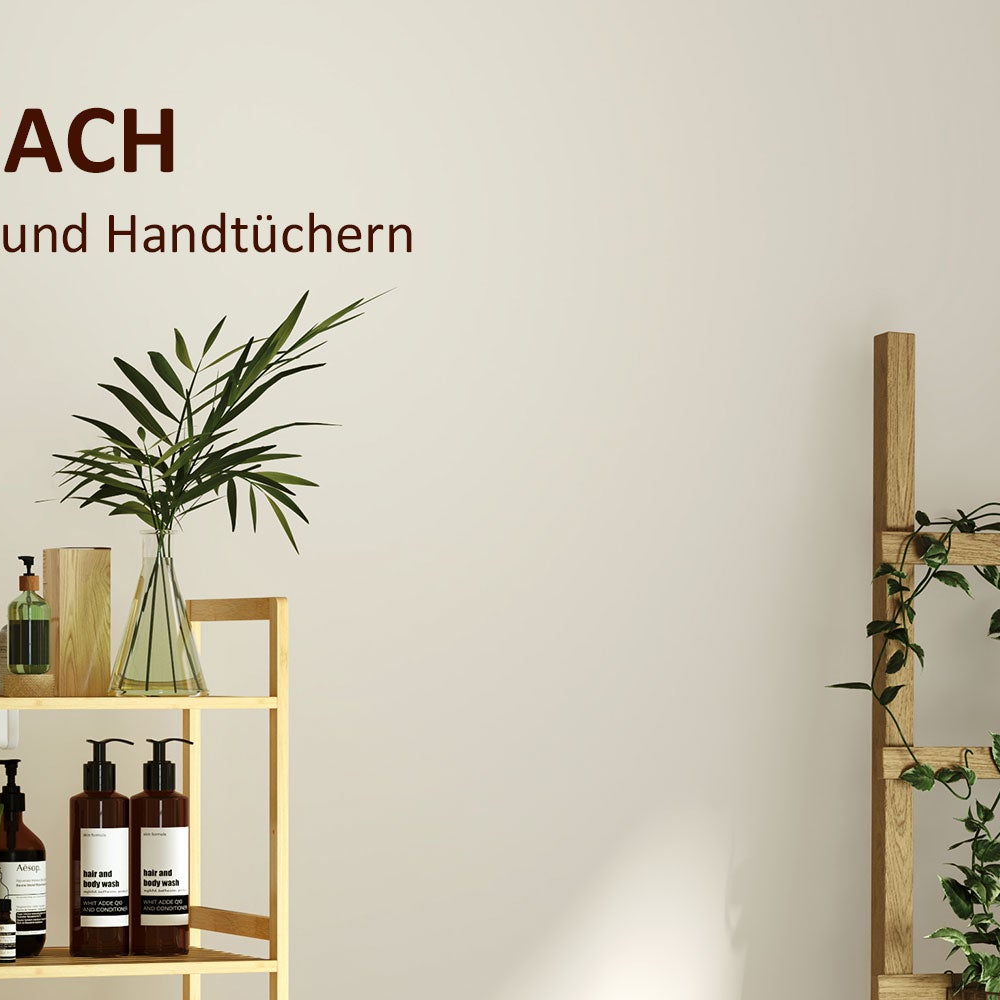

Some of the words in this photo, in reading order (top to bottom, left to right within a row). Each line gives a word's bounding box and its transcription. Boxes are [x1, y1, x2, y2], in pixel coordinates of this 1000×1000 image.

[83, 870, 97, 878] hair
[98, 870, 113, 878] and
[143, 869, 158, 877] hair
[158, 869, 173, 877] and
[83, 880, 101, 889] body
[101, 880, 120, 888] wash
[143, 879, 161, 888] body
[161, 879, 180, 887] wash
